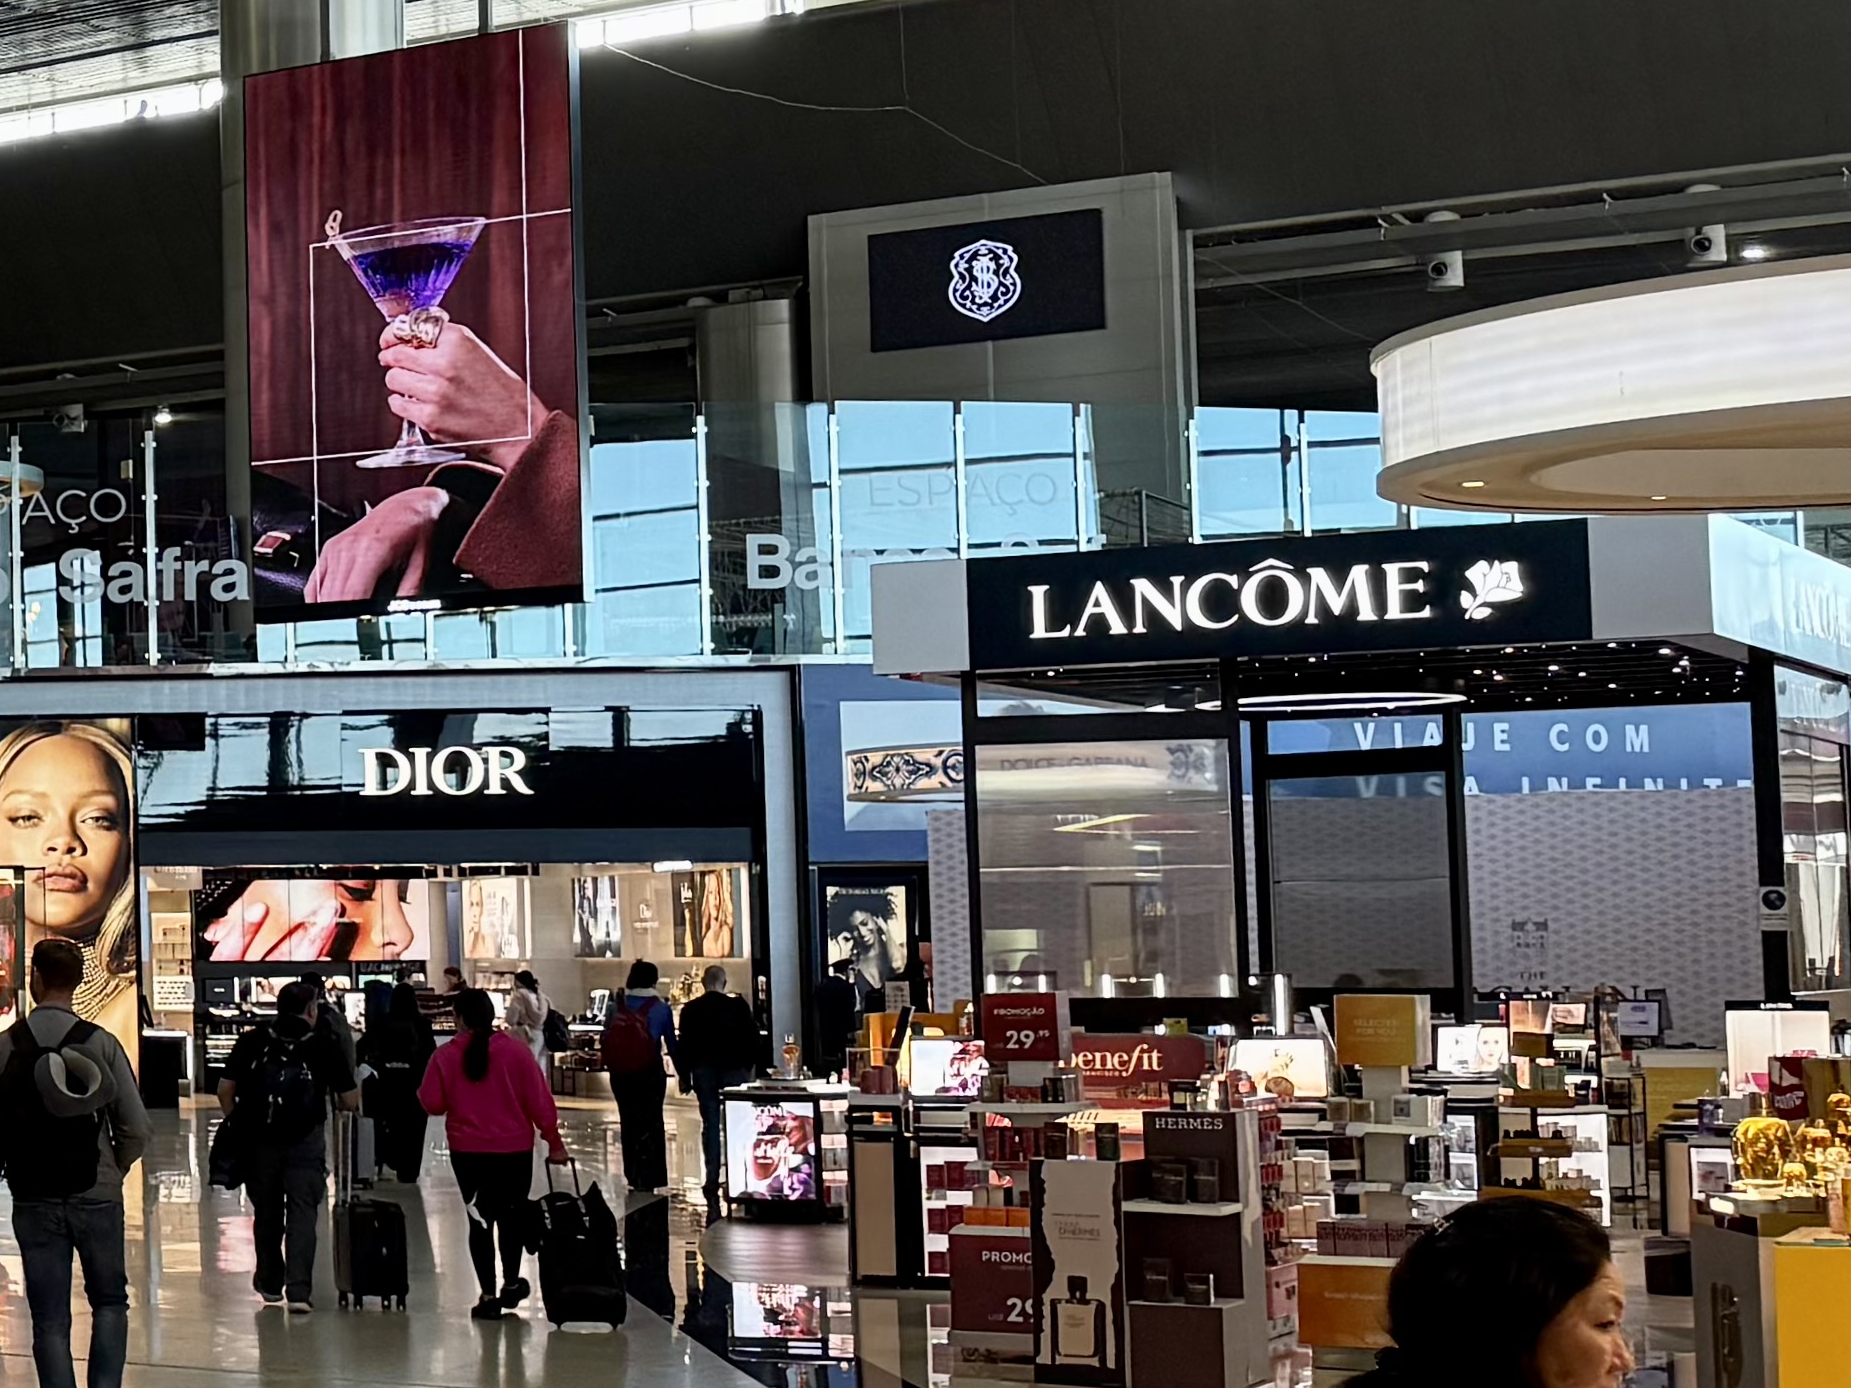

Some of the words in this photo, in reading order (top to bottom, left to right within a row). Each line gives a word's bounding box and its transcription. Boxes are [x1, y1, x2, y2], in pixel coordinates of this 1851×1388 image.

[58, 546, 250, 607] Safra
[1027, 557, 1431, 640] LANCÔME
[1353, 721, 1511, 752] VIAJE
[1549, 722, 1650, 753] COM
[358, 745, 535, 797] DIOR
